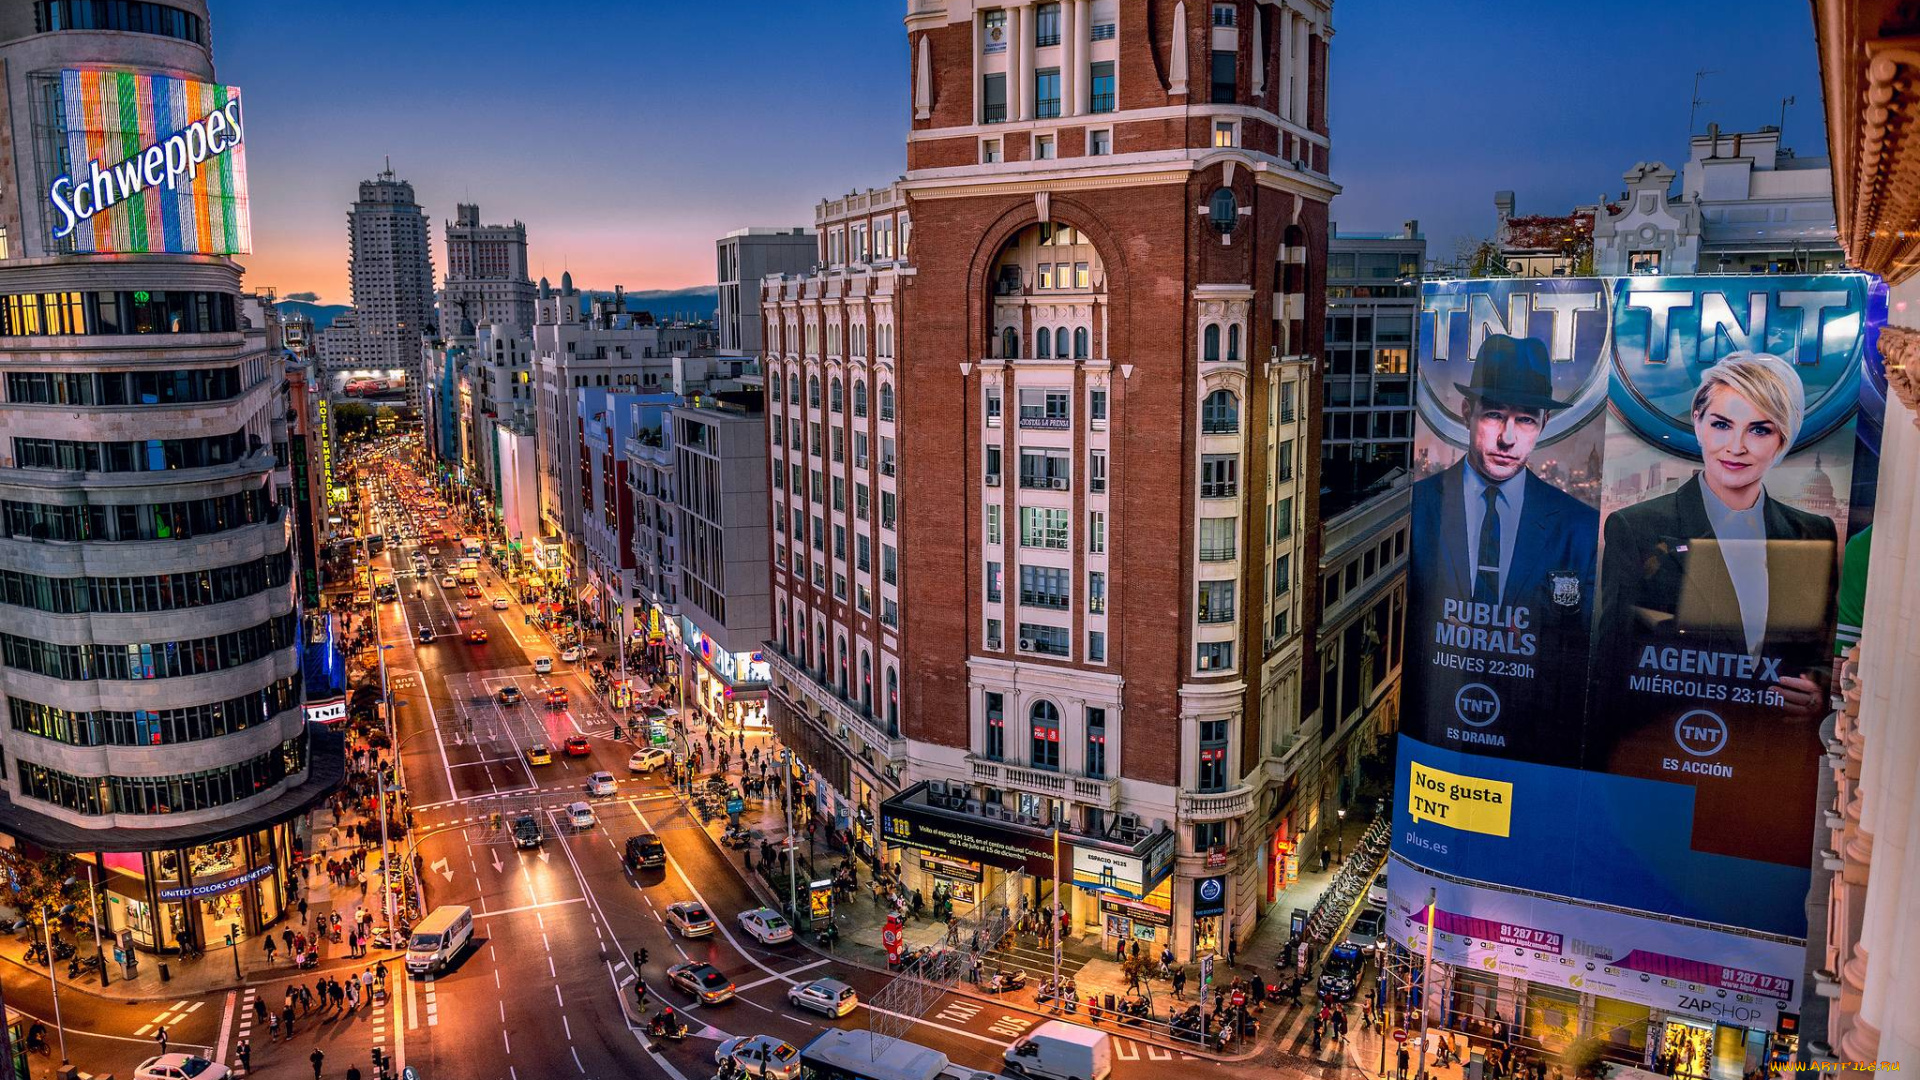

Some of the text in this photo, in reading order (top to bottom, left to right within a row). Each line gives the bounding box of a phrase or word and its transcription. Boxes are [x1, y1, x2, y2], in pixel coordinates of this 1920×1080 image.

[51, 98, 242, 238] Schweppes
[1422, 292, 1601, 362] TNT
[1626, 291, 1850, 366] TNT
[1050, 419, 1069, 427] PRENSA
[320, 400, 334, 505] HOTEL EMPERADOR
[296, 441, 318, 603] HOTEL REX
[1443, 598, 1530, 629] PUBLIC
[1436, 622, 1536, 656] MORALS
[1433, 651, 1534, 679] JUEVES 22:30h
[1638, 645, 1782, 682] AGENTE X
[1629, 673, 1784, 707] MIÉRCOLES 23:15h
[1461, 698, 1494, 714] TNT
[1447, 727, 1506, 747] ES DRAMA
[1682, 725, 1720, 742] TNT
[1663, 758, 1733, 778] ES ACCIÓN
[1415, 771, 1502, 804] Nos gusta
[1414, 795, 1449, 818] TNT
[938, 831, 956, 839] espacio
[1042, 852, 1054, 860] Duq
[1406, 831, 1448, 855] plus.es
[1088, 854, 1111, 864] ESPACIO
[161, 889, 191, 898] UNITED
[193, 881, 226, 895] COLORS
[228, 879, 239, 887] OF
[1500, 925, 1560, 946] 91 287 17 20
[1736, 971, 1758, 985] 287
[1760, 975, 1772, 989] 17
[1774, 980, 1789, 992] 20
[935, 1000, 984, 1023] TAXI
[1678, 995, 1761, 1022] ZAPSHOP
[988, 1016, 1031, 1037] BUS
